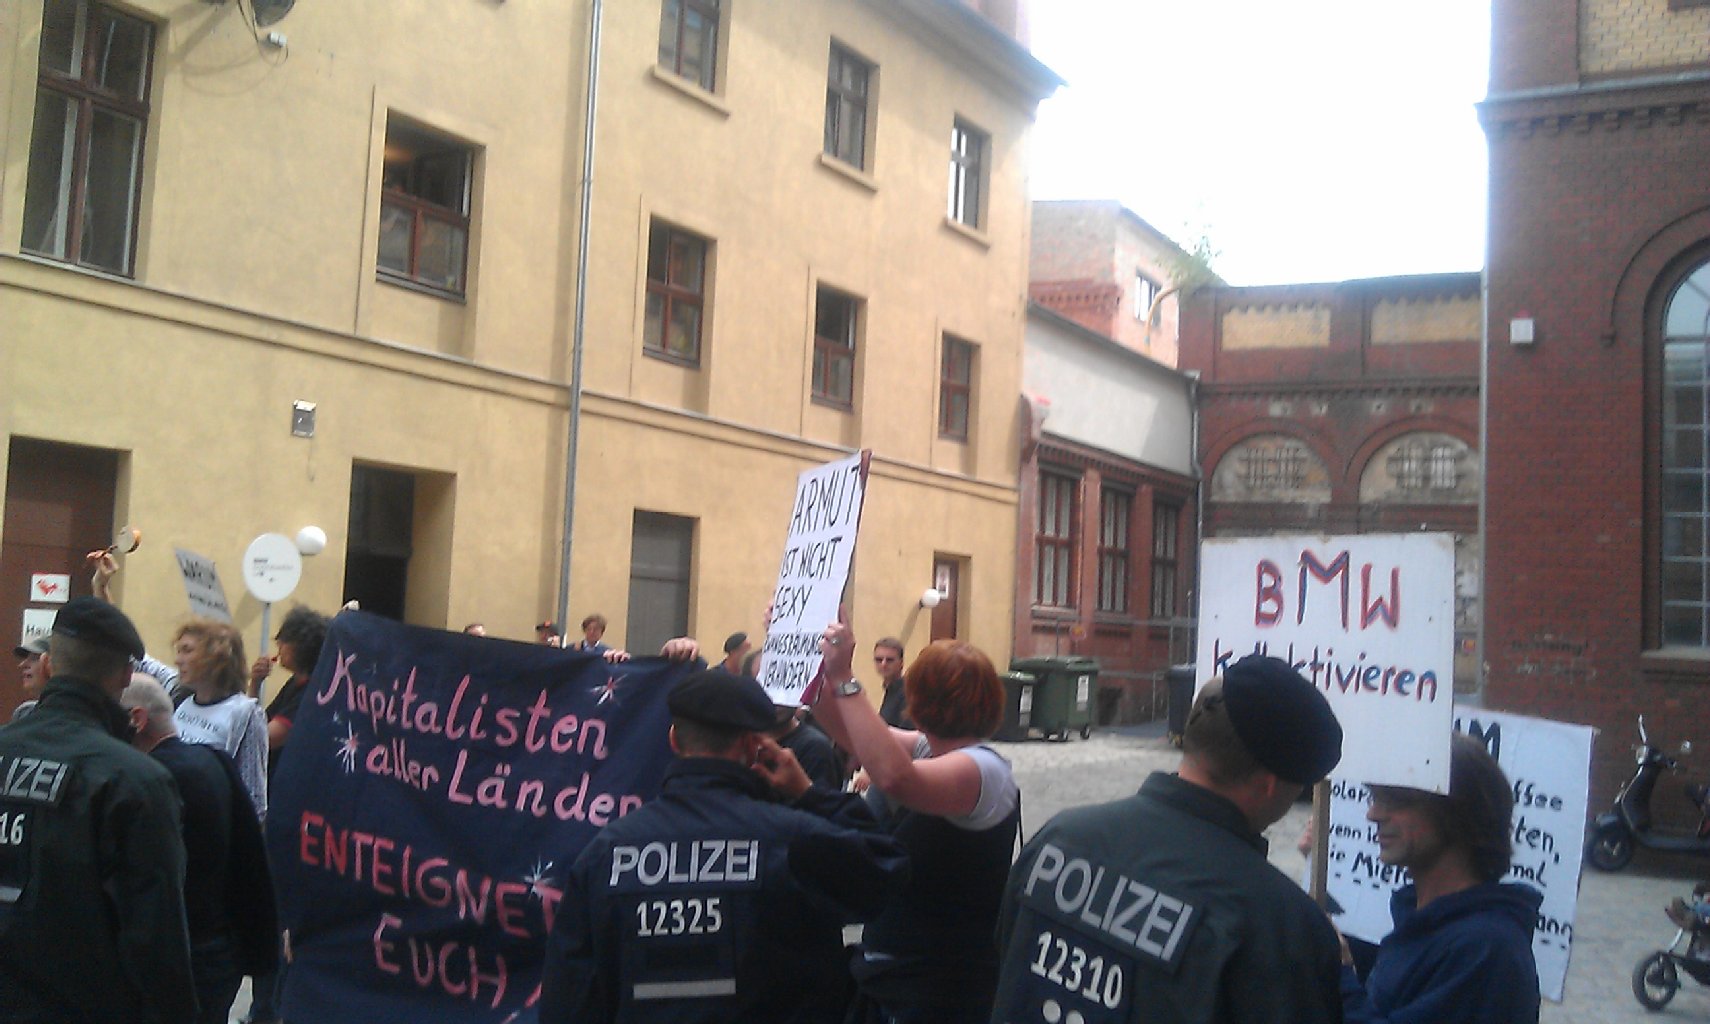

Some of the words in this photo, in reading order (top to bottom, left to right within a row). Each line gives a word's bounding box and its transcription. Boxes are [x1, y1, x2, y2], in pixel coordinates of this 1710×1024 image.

[789, 464, 861, 537] ARMUT
[797, 536, 843, 581] NICHT
[1254, 549, 1401, 633] BMW
[773, 584, 814, 626] SEXY
[316, 648, 609, 761] Kapitalisten
[365, 738, 440, 791] aller
[447, 749, 643, 827] Länder
[1513, 777, 1564, 812] ffee
[300, 810, 563, 939] ENTEIGNET
[609, 839, 760, 887] POLIZEI
[1513, 815, 1561, 865] ten,
[636, 897, 723, 937] 12325
[1024, 843, 1194, 962] POLIZEI
[1030, 930, 1124, 1010] 12310
